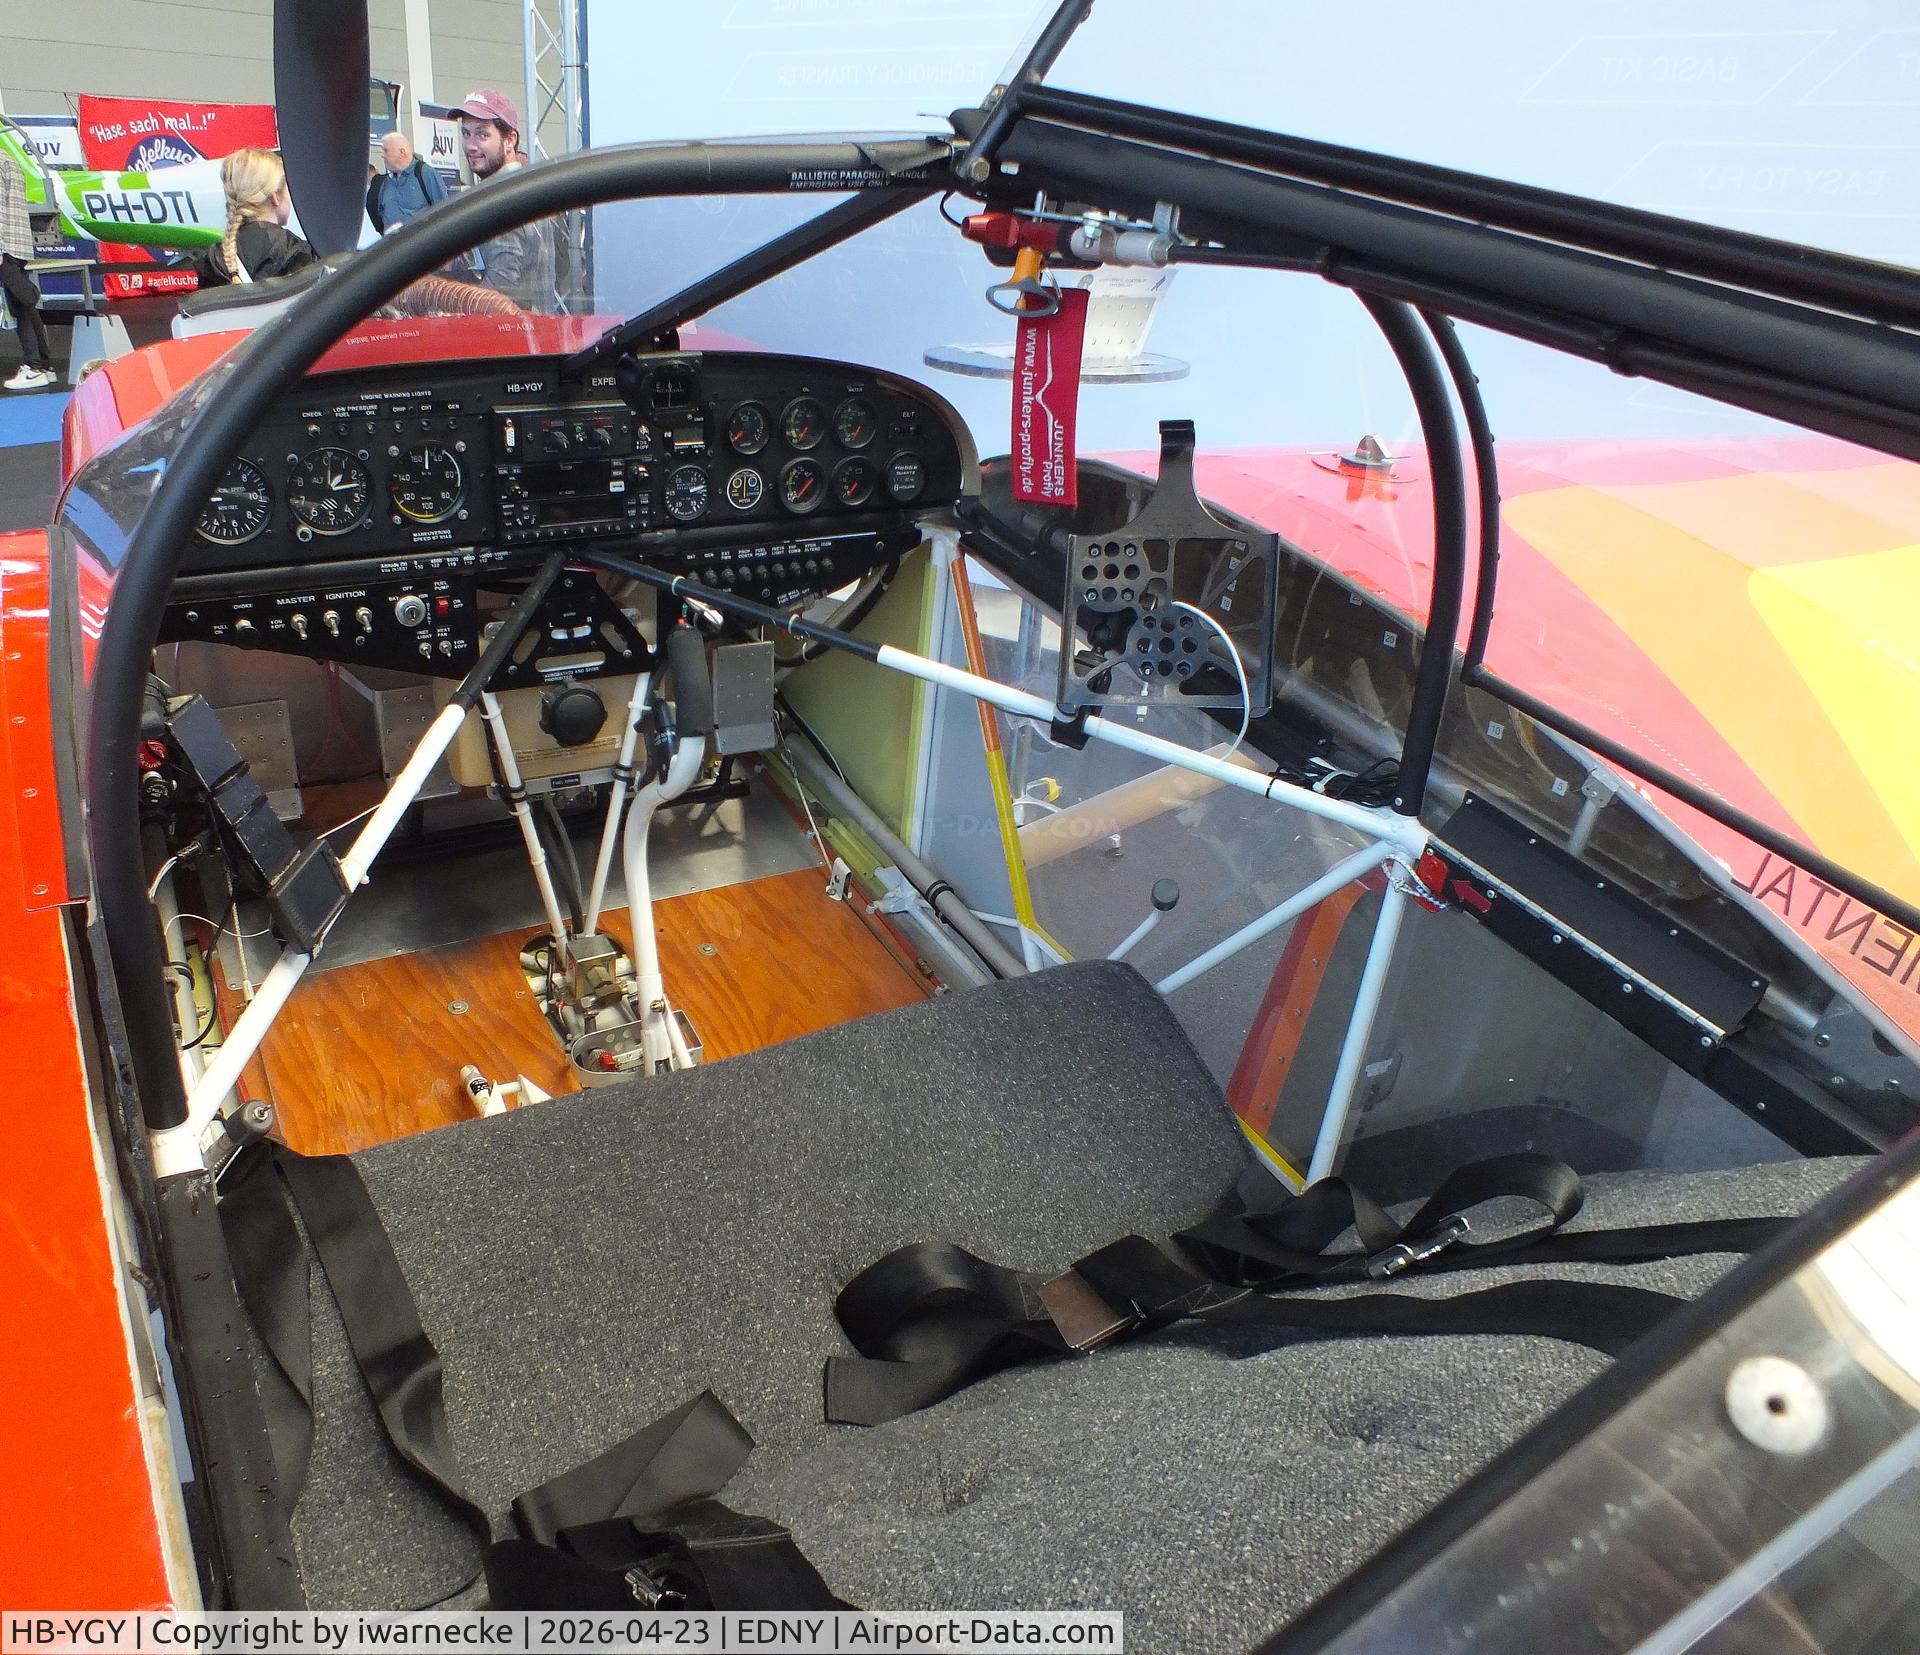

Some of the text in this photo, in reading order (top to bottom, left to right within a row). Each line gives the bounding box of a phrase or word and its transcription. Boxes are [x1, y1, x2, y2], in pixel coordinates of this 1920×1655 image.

[129, 112, 159, 134] sach
[791, 171, 837, 181] BALLISTIC
[789, 180, 845, 189] EMERGENCY
[847, 180, 865, 188] USE
[85, 190, 199, 224] PH-DTI
[591, 377, 617, 387] EXPE
[507, 382, 543, 393] HB-YGY
[360, 393, 383, 401] ENGINE
[384, 391, 411, 399] WARNING
[347, 404, 378, 412] PRESSURE
[1020, 327, 1037, 494] www.junkers-profly.de
[1053, 419, 1065, 497] JUNKERS
[351, 469, 358, 480] 2
[353, 492, 361, 503] 3
[403, 493, 415, 501] 120
[421, 502, 434, 510] 100
[231, 519, 239, 528] 6
[276, 595, 316, 605] MASTER
[325, 590, 366, 601] IGNITION
